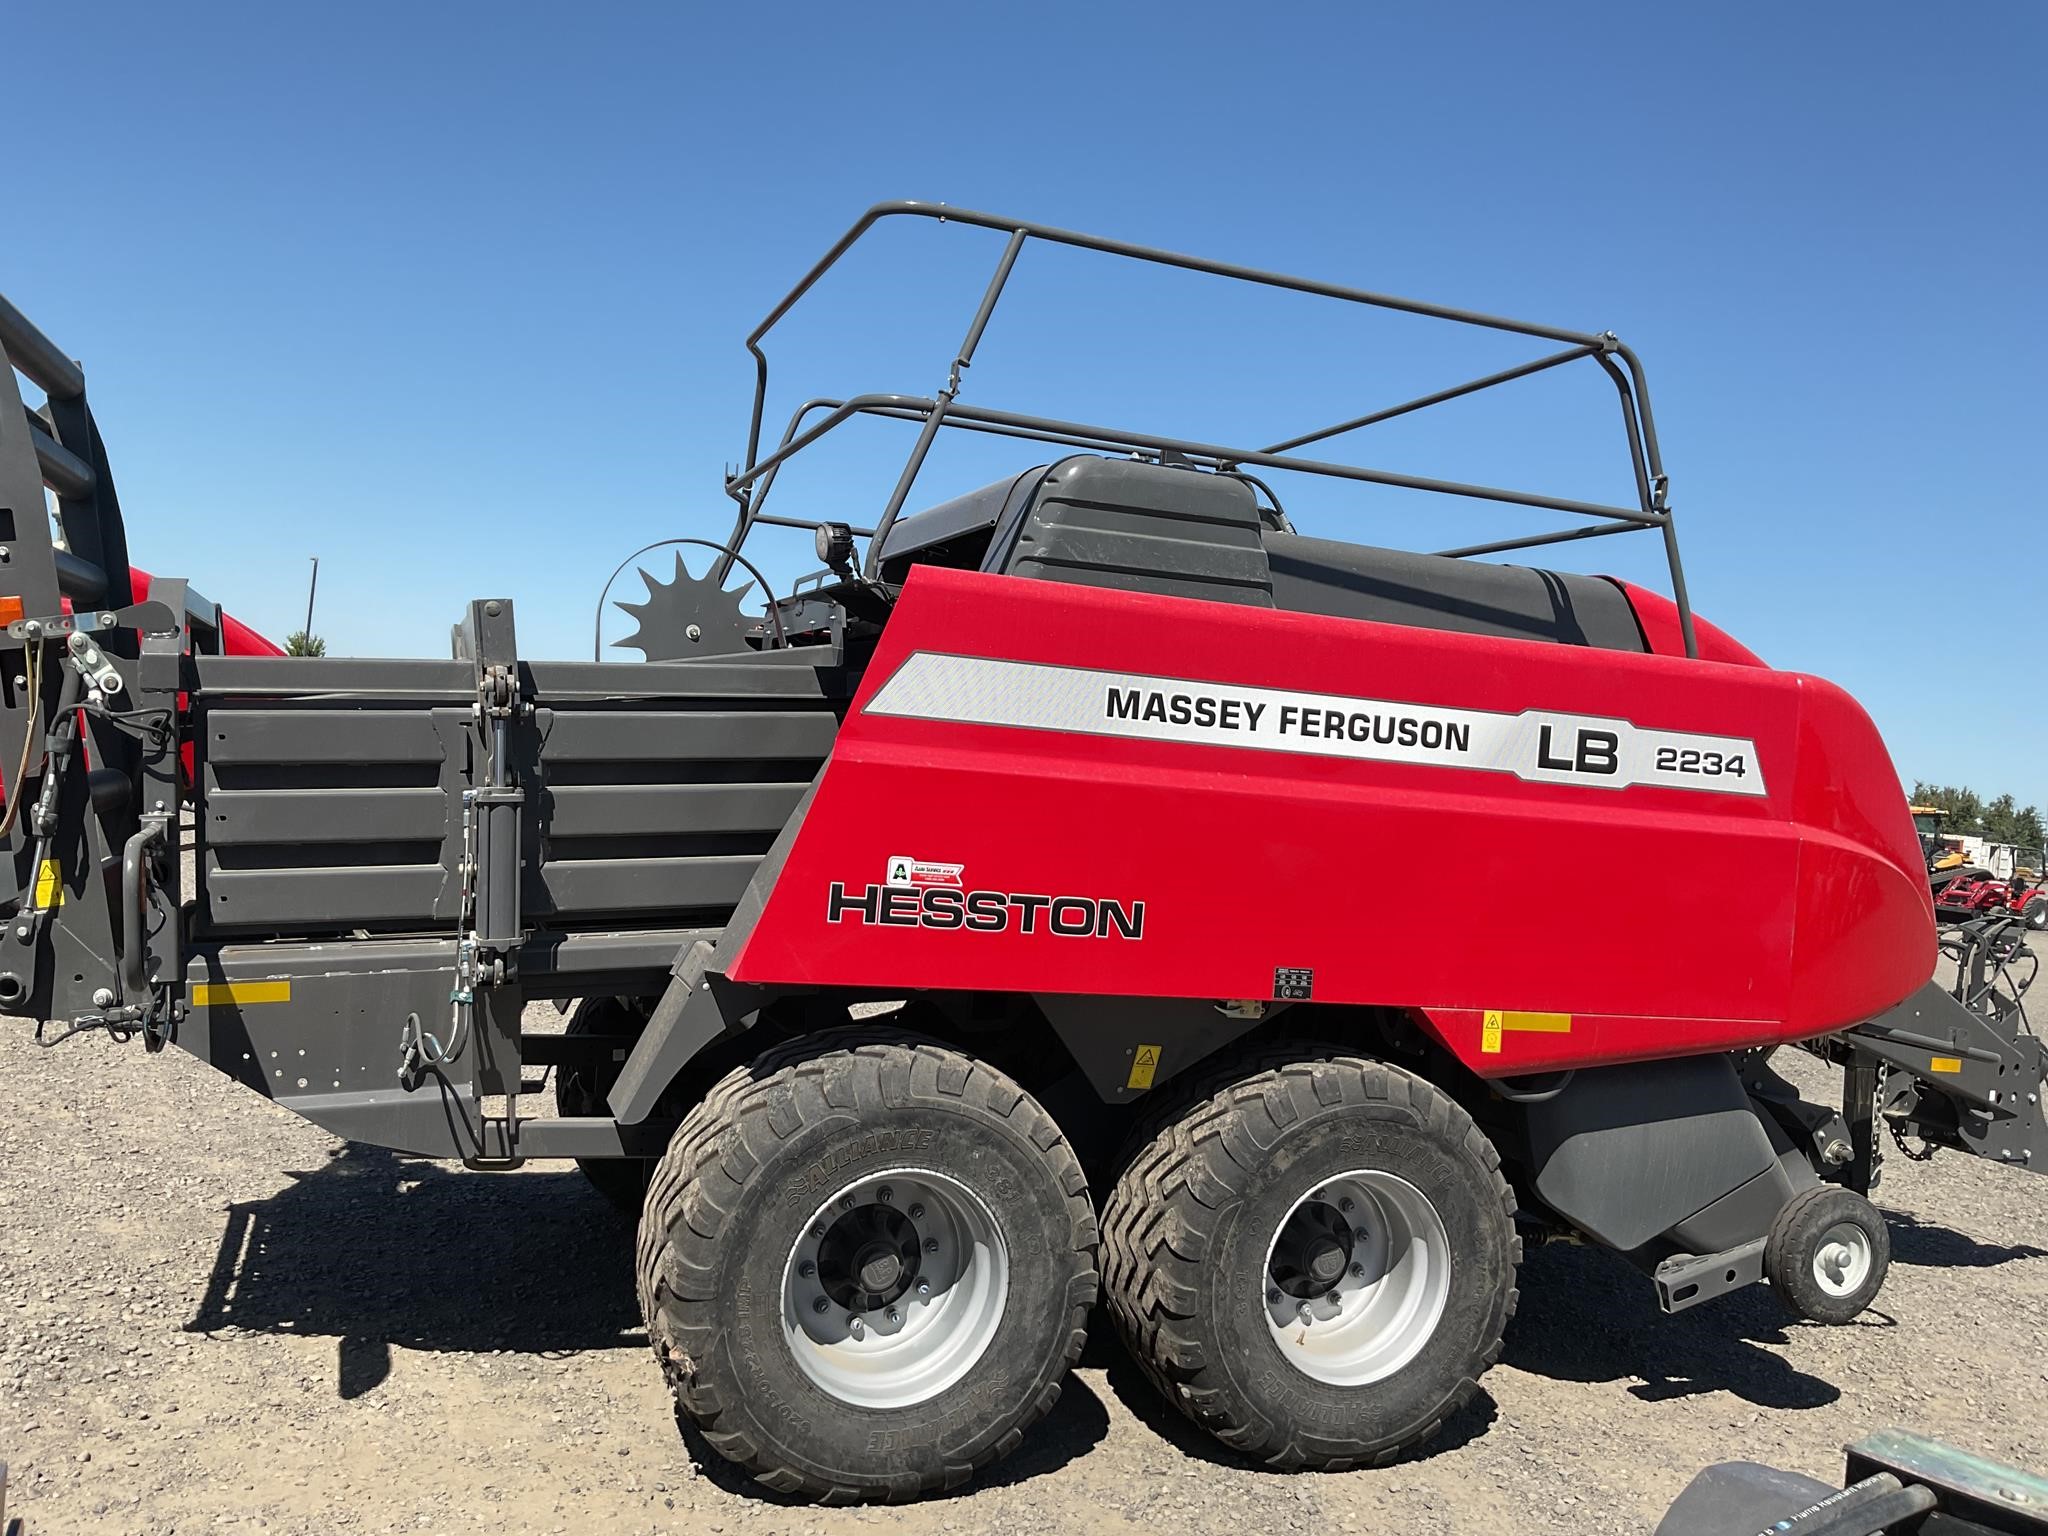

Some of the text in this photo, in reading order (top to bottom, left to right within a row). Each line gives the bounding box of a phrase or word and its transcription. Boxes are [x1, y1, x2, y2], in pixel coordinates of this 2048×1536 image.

[1106, 687, 1471, 752] MASSEY FERGUSON
[1537, 725, 1746, 778] LB 2234
[828, 882, 1145, 939] HESSTON
[806, 1127, 937, 1195] ALLIANCE
